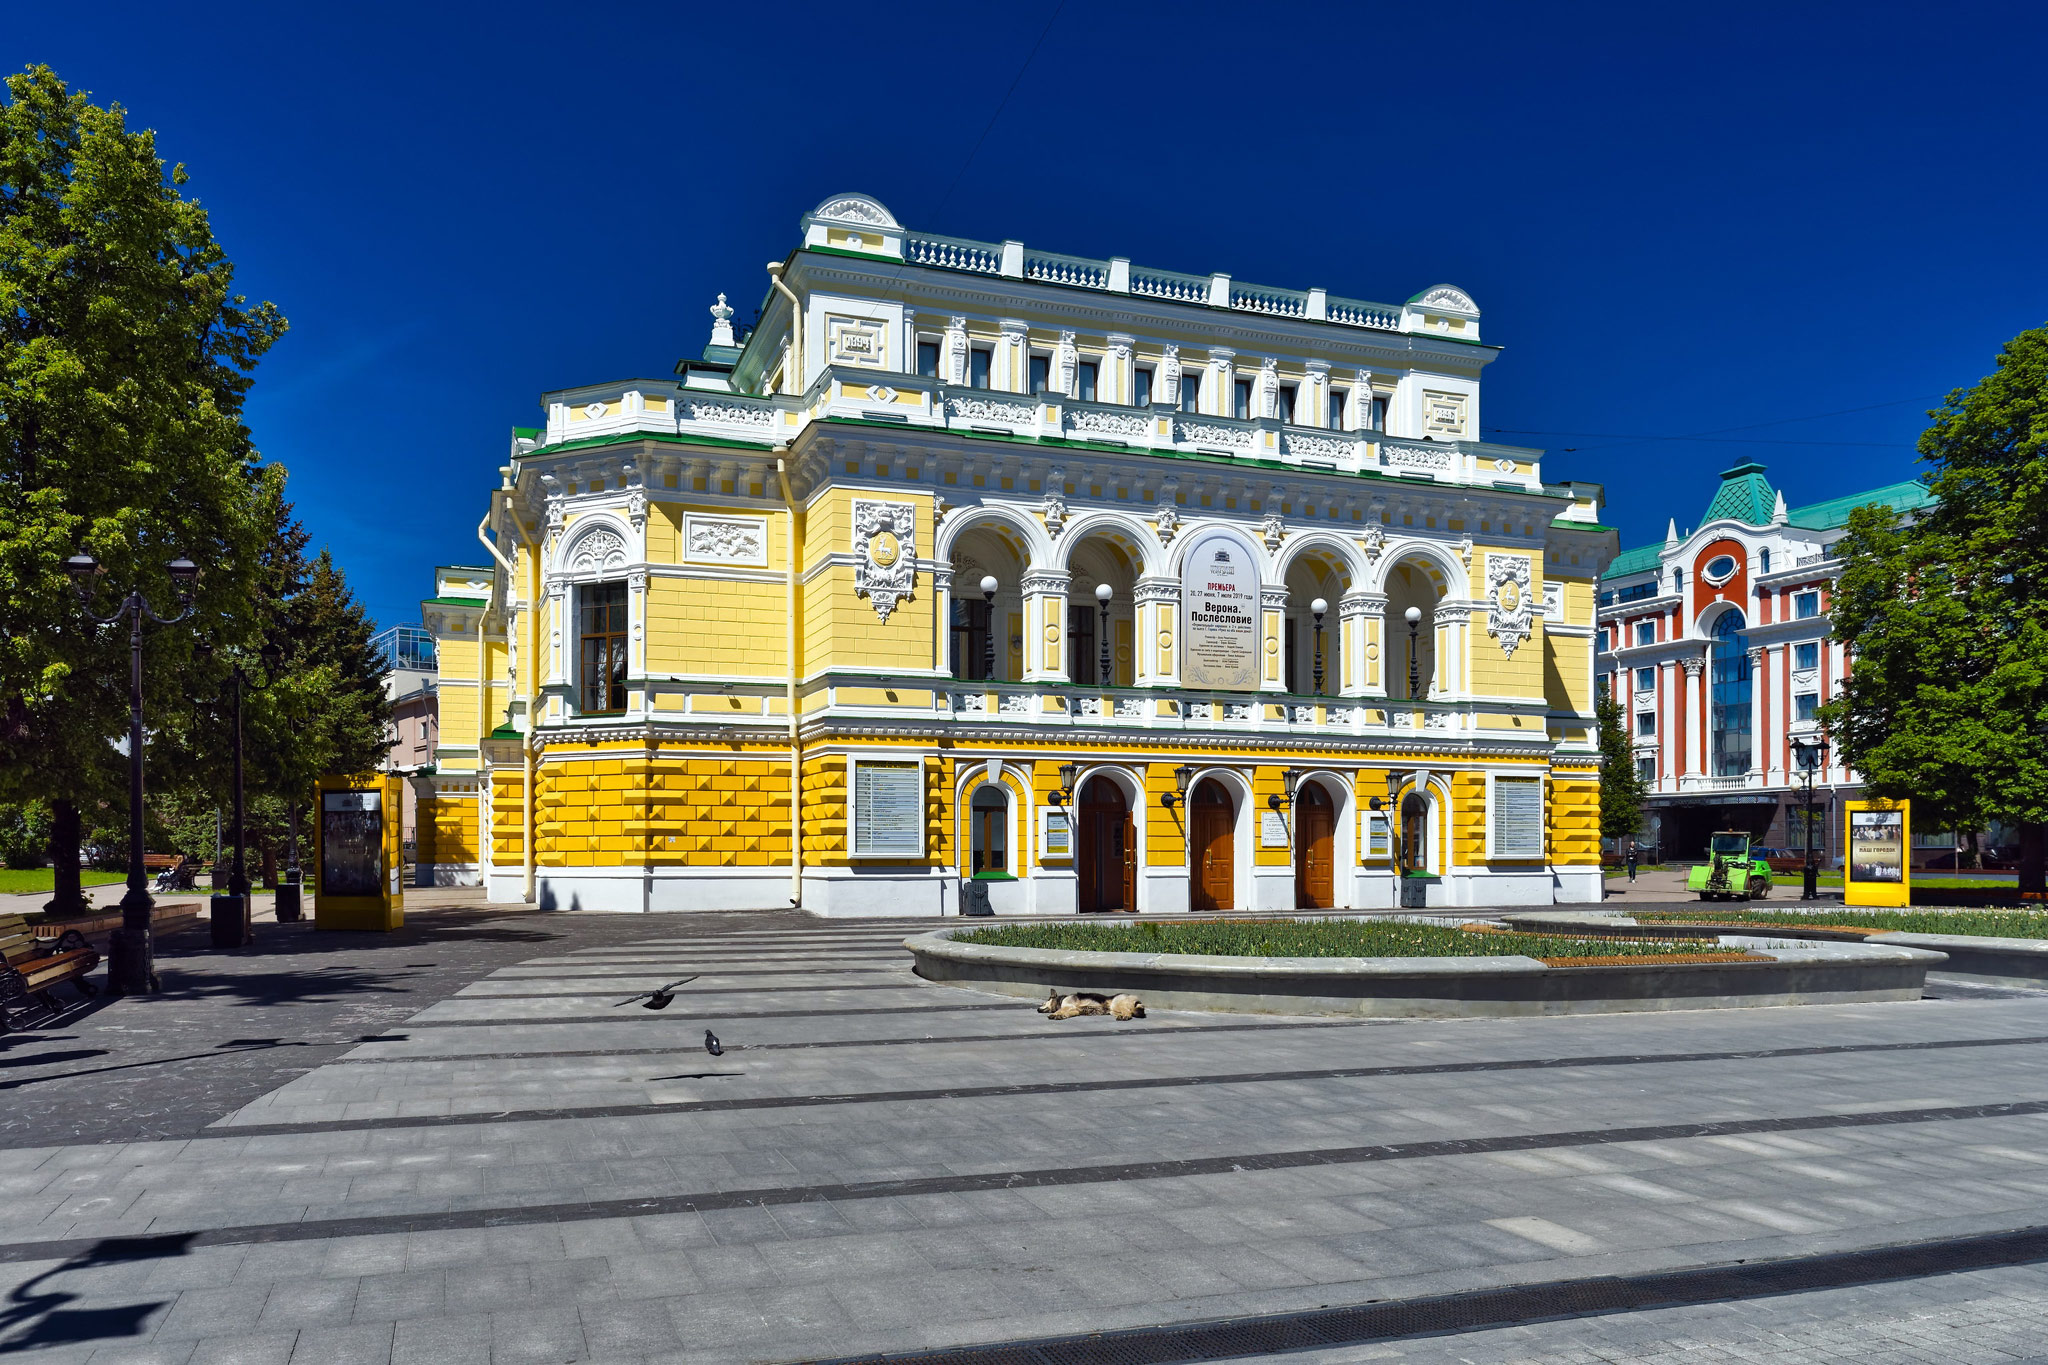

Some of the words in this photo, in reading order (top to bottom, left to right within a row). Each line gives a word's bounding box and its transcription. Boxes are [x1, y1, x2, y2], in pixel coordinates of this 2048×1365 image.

[1207, 582, 1236, 592] ПРЕМЬЕРА
[1205, 601, 1242, 614] Верона.
[1191, 611, 1252, 625] Послесловие
